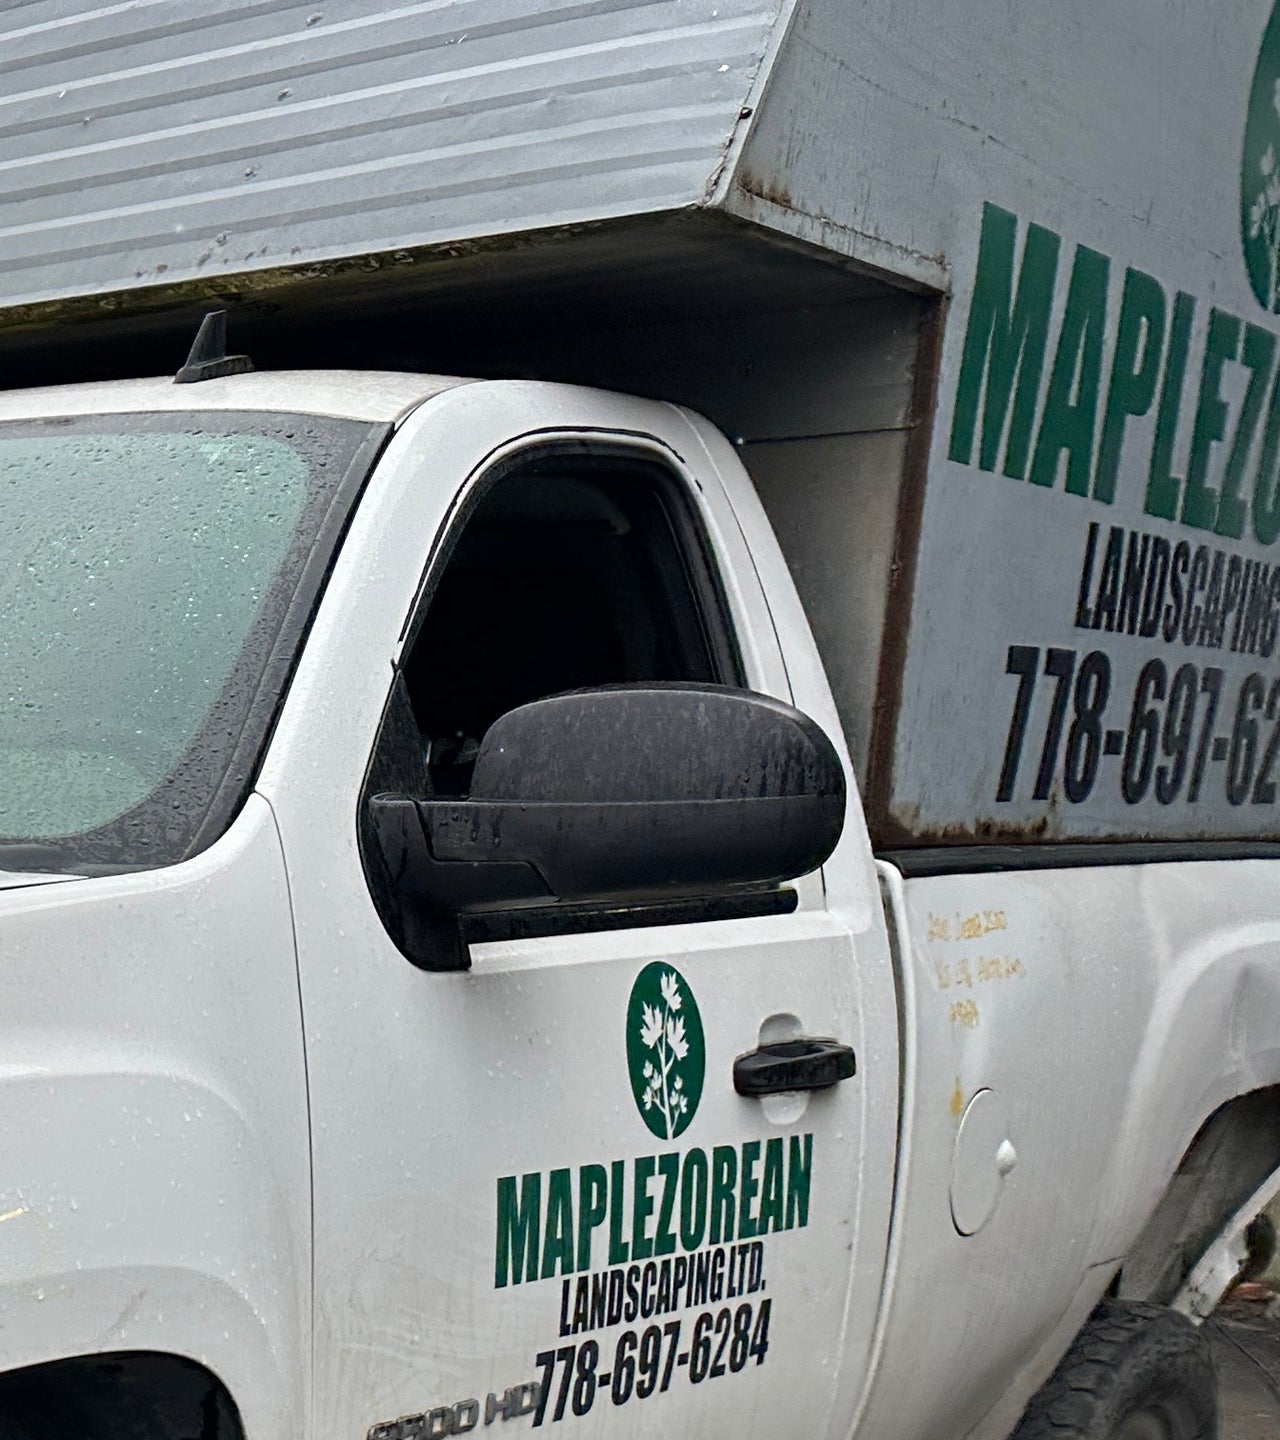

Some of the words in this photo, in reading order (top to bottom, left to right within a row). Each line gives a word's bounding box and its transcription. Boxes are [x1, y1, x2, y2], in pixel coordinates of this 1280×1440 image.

[494, 1133, 813, 1289] MAPLEZOREAN
[559, 1247, 724, 1338] LANDSCAPING
[726, 1240, 767, 1299] LTD.
[484, 1381, 542, 1426] HD
[532, 1299, 773, 1428] 778-697-6284
